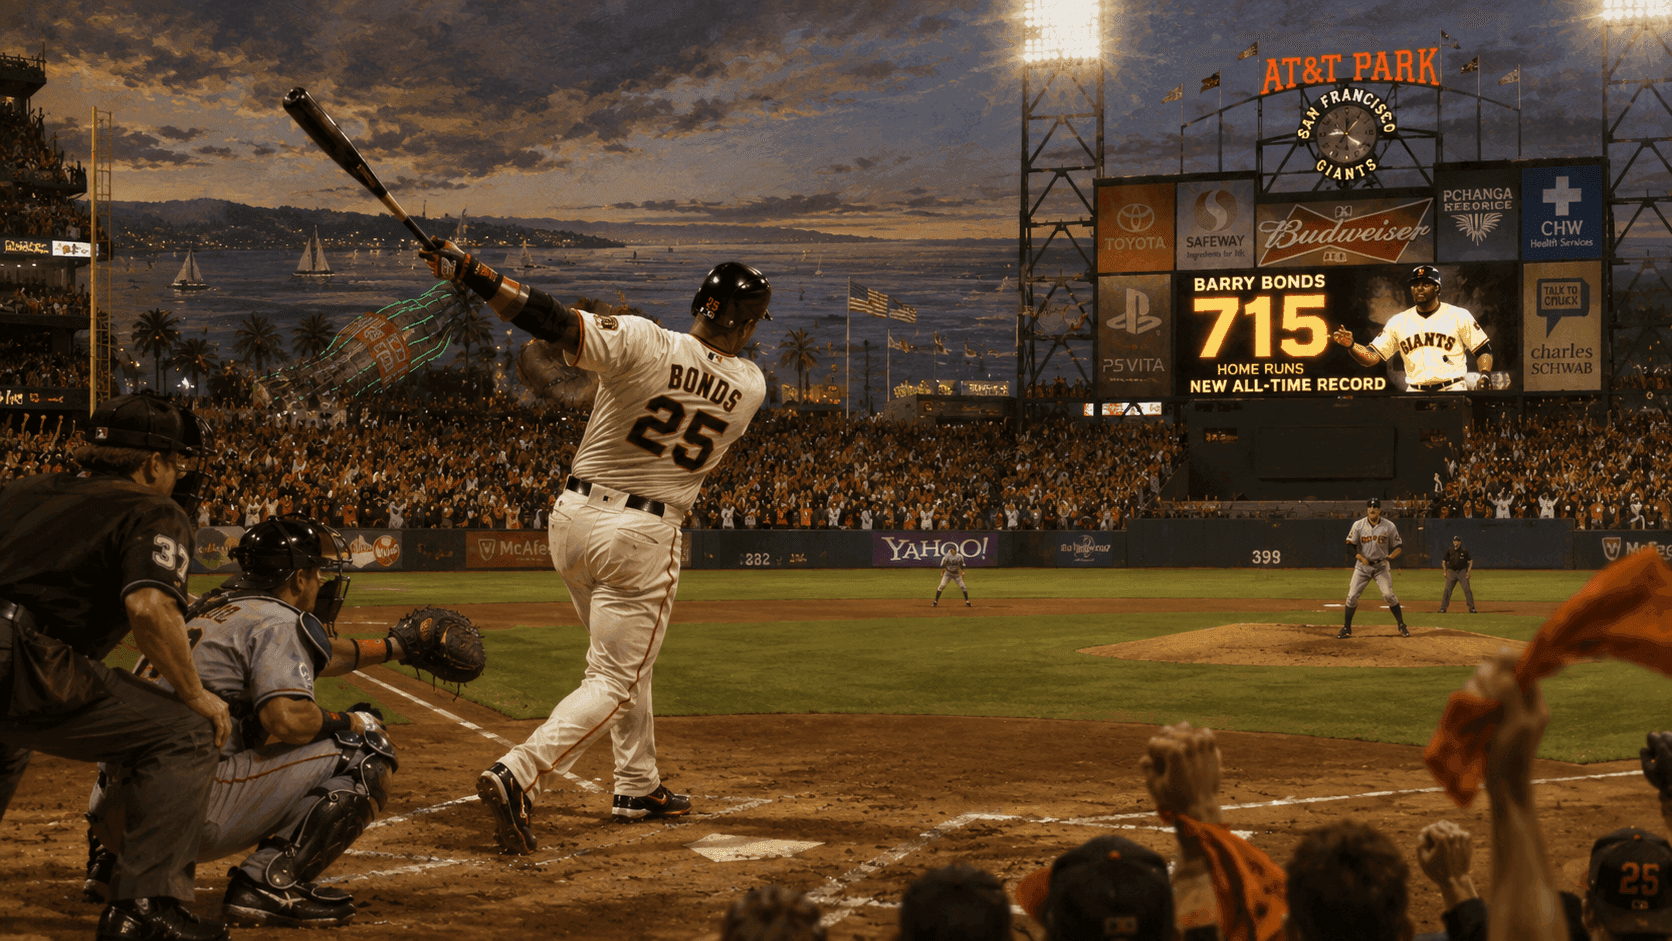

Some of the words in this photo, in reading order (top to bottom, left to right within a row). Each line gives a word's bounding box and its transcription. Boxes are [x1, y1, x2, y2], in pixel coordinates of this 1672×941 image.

[1260, 53, 1342, 95] AT&T
[1353, 47, 1440, 86] PARK
[1298, 106, 1320, 139] SAN
[1320, 88, 1396, 133] FRANCISCO
[1316, 158, 1377, 180] GIANTS
[1443, 187, 1513, 202] PCHANGA
[1258, 218, 1431, 249] Budweiser
[1541, 220, 1583, 236] CHW
[1104, 236, 1166, 251] TOYOTA
[1186, 235, 1245, 248] SAFEWAY
[1194, 276, 1255, 291] BARRY
[1261, 274, 1326, 290] BONDS
[1544, 286, 1565, 295] TALK
[1567, 286, 1578, 294] TO
[705, 296, 720, 312] 25
[1193, 294, 1328, 358] 715
[1400, 332, 1457, 355] GIANTS
[1126, 358, 1165, 372] VITA
[1217, 363, 1260, 375] HOME
[1264, 363, 1304, 375] RUNS
[1531, 363, 1593, 375] SCHWAB
[668, 363, 743, 413] BONDS
[1190, 379, 1228, 393] NEW
[1232, 378, 1312, 392] ALL-TIME
[1317, 377, 1386, 391] RECORD
[625, 394, 730, 473] 25
[152, 533, 189, 583] 37
[881, 536, 988, 561] YAHOO!
[1620, 861, 1660, 896] 25
